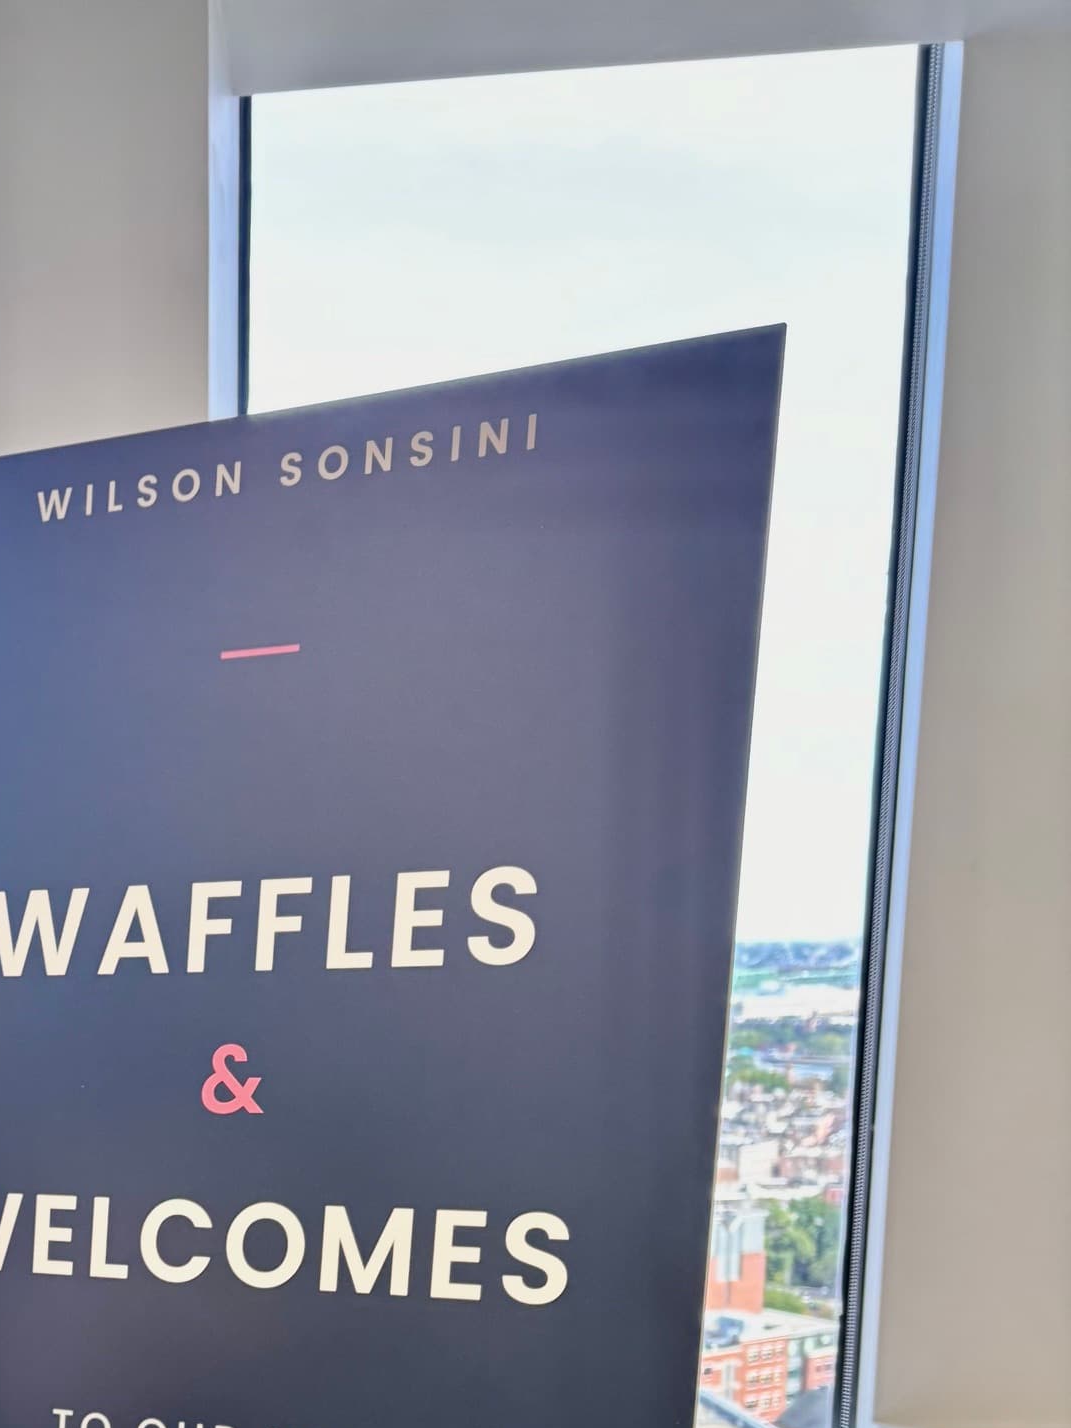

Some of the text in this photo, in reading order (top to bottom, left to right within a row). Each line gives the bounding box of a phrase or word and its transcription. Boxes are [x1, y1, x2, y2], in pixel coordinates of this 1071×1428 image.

[37, 411, 540, 522] WILSON SONSINI
[201, 1043, 264, 1115] &
